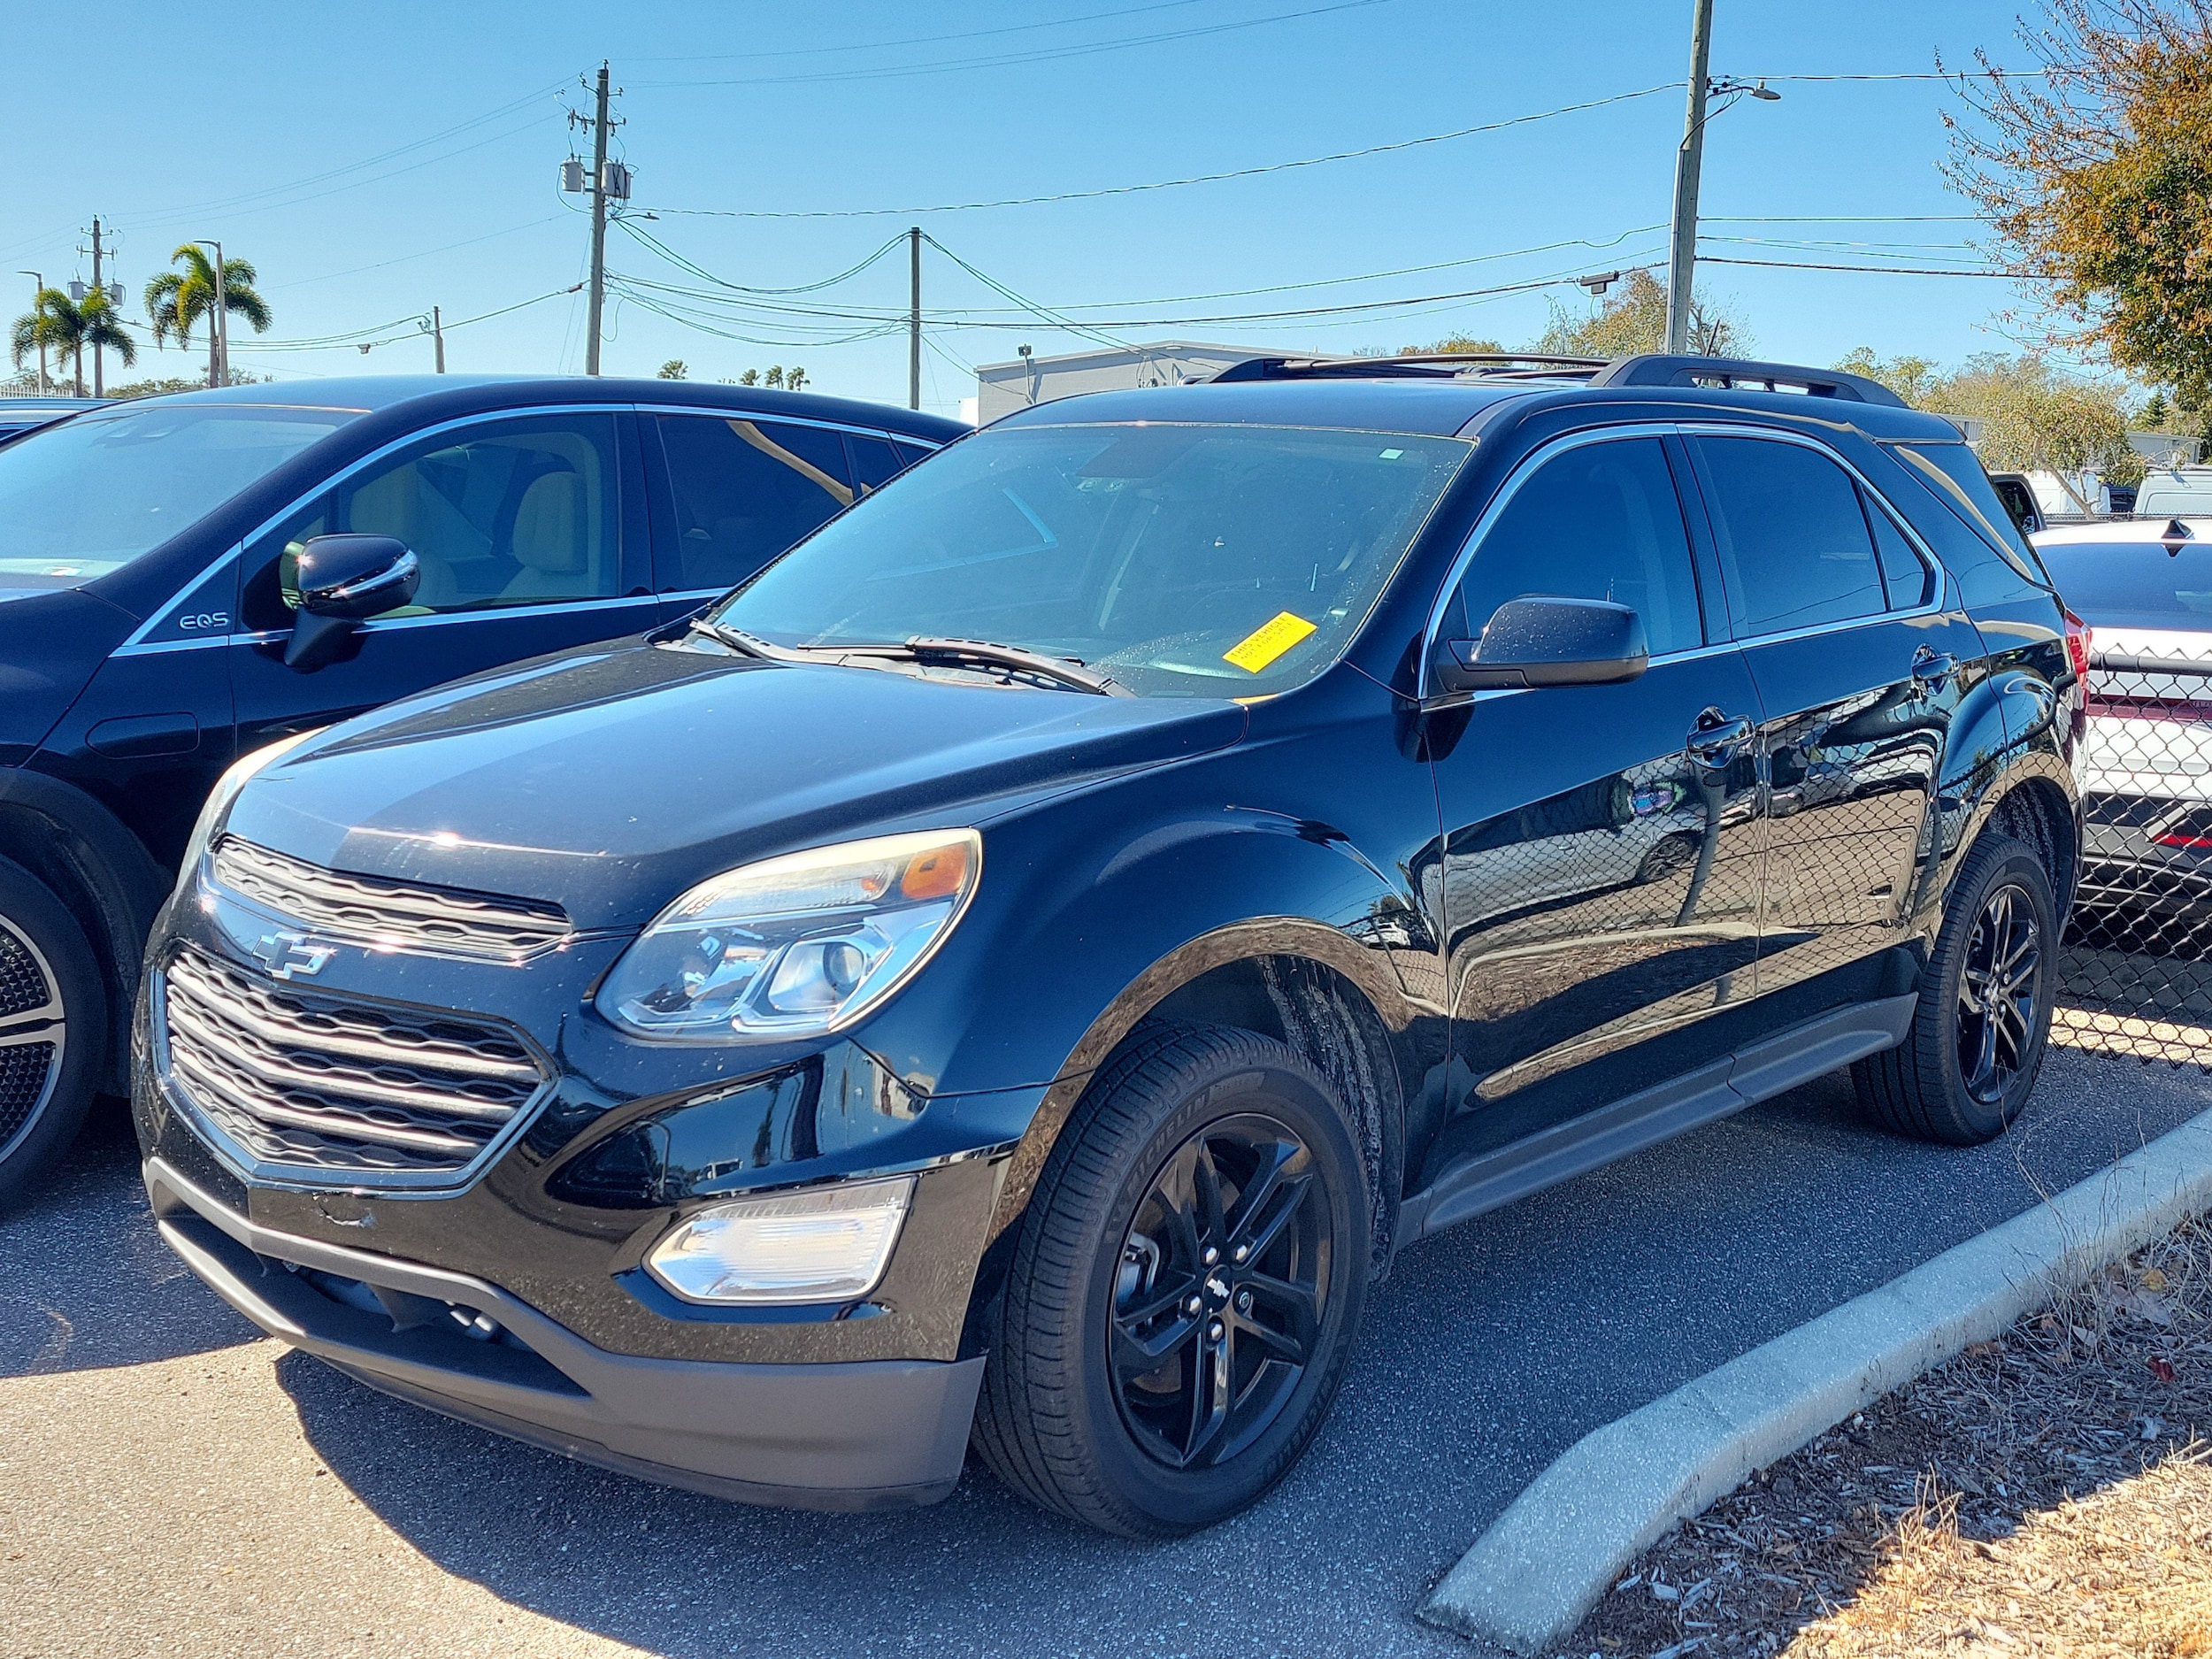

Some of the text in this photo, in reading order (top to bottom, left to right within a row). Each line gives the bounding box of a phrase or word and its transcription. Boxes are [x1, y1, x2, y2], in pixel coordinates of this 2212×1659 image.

[180, 612, 228, 629] EQS
[1271, 620, 1294, 635] SALE
[1229, 641, 1253, 657] THIS
[1249, 615, 1288, 643] VEHICLE
[1127, 1094, 1207, 1197] MICHELIN
